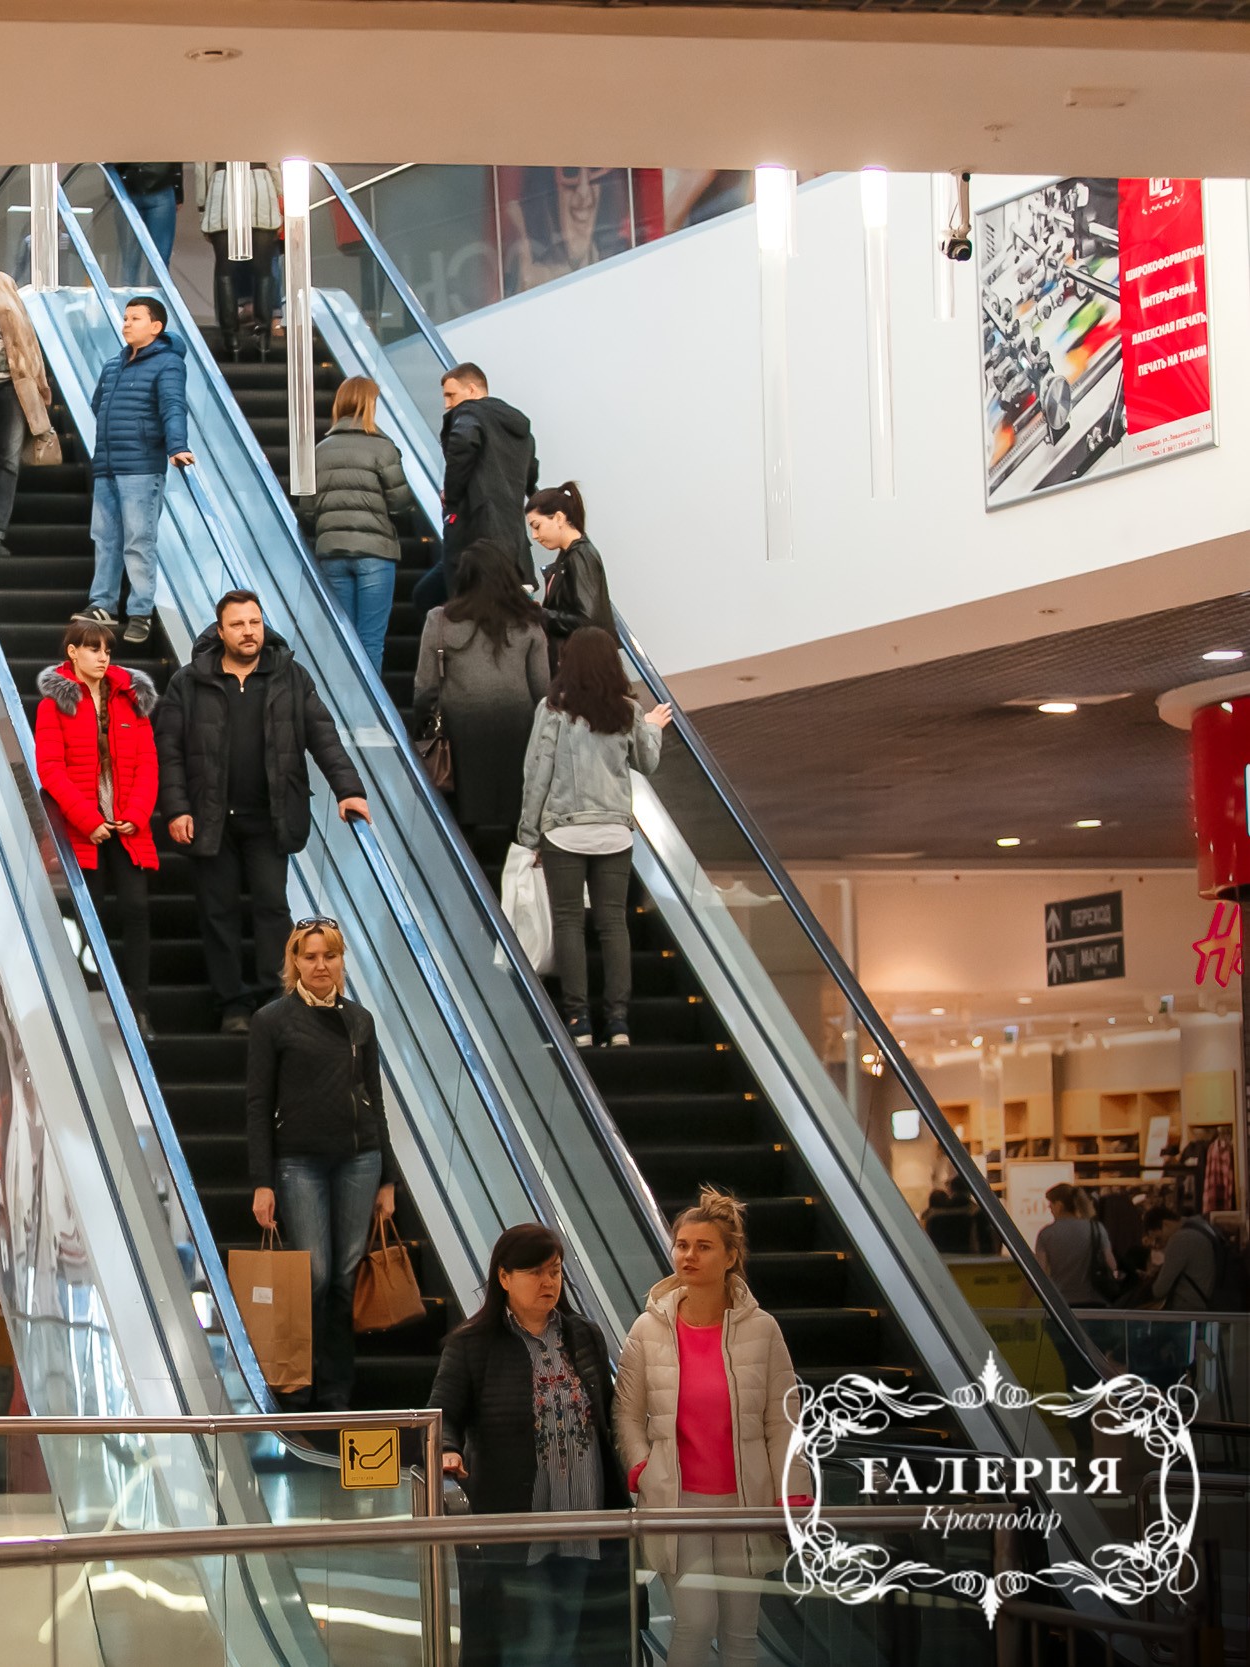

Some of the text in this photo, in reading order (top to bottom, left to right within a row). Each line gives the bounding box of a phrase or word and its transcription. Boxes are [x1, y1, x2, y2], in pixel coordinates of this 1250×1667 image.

[1132, 321, 1175, 345] ЛАТЕКСНАЯ
[1137, 344, 1207, 377] ПЕЧАТЬ НА ТКАНИ
